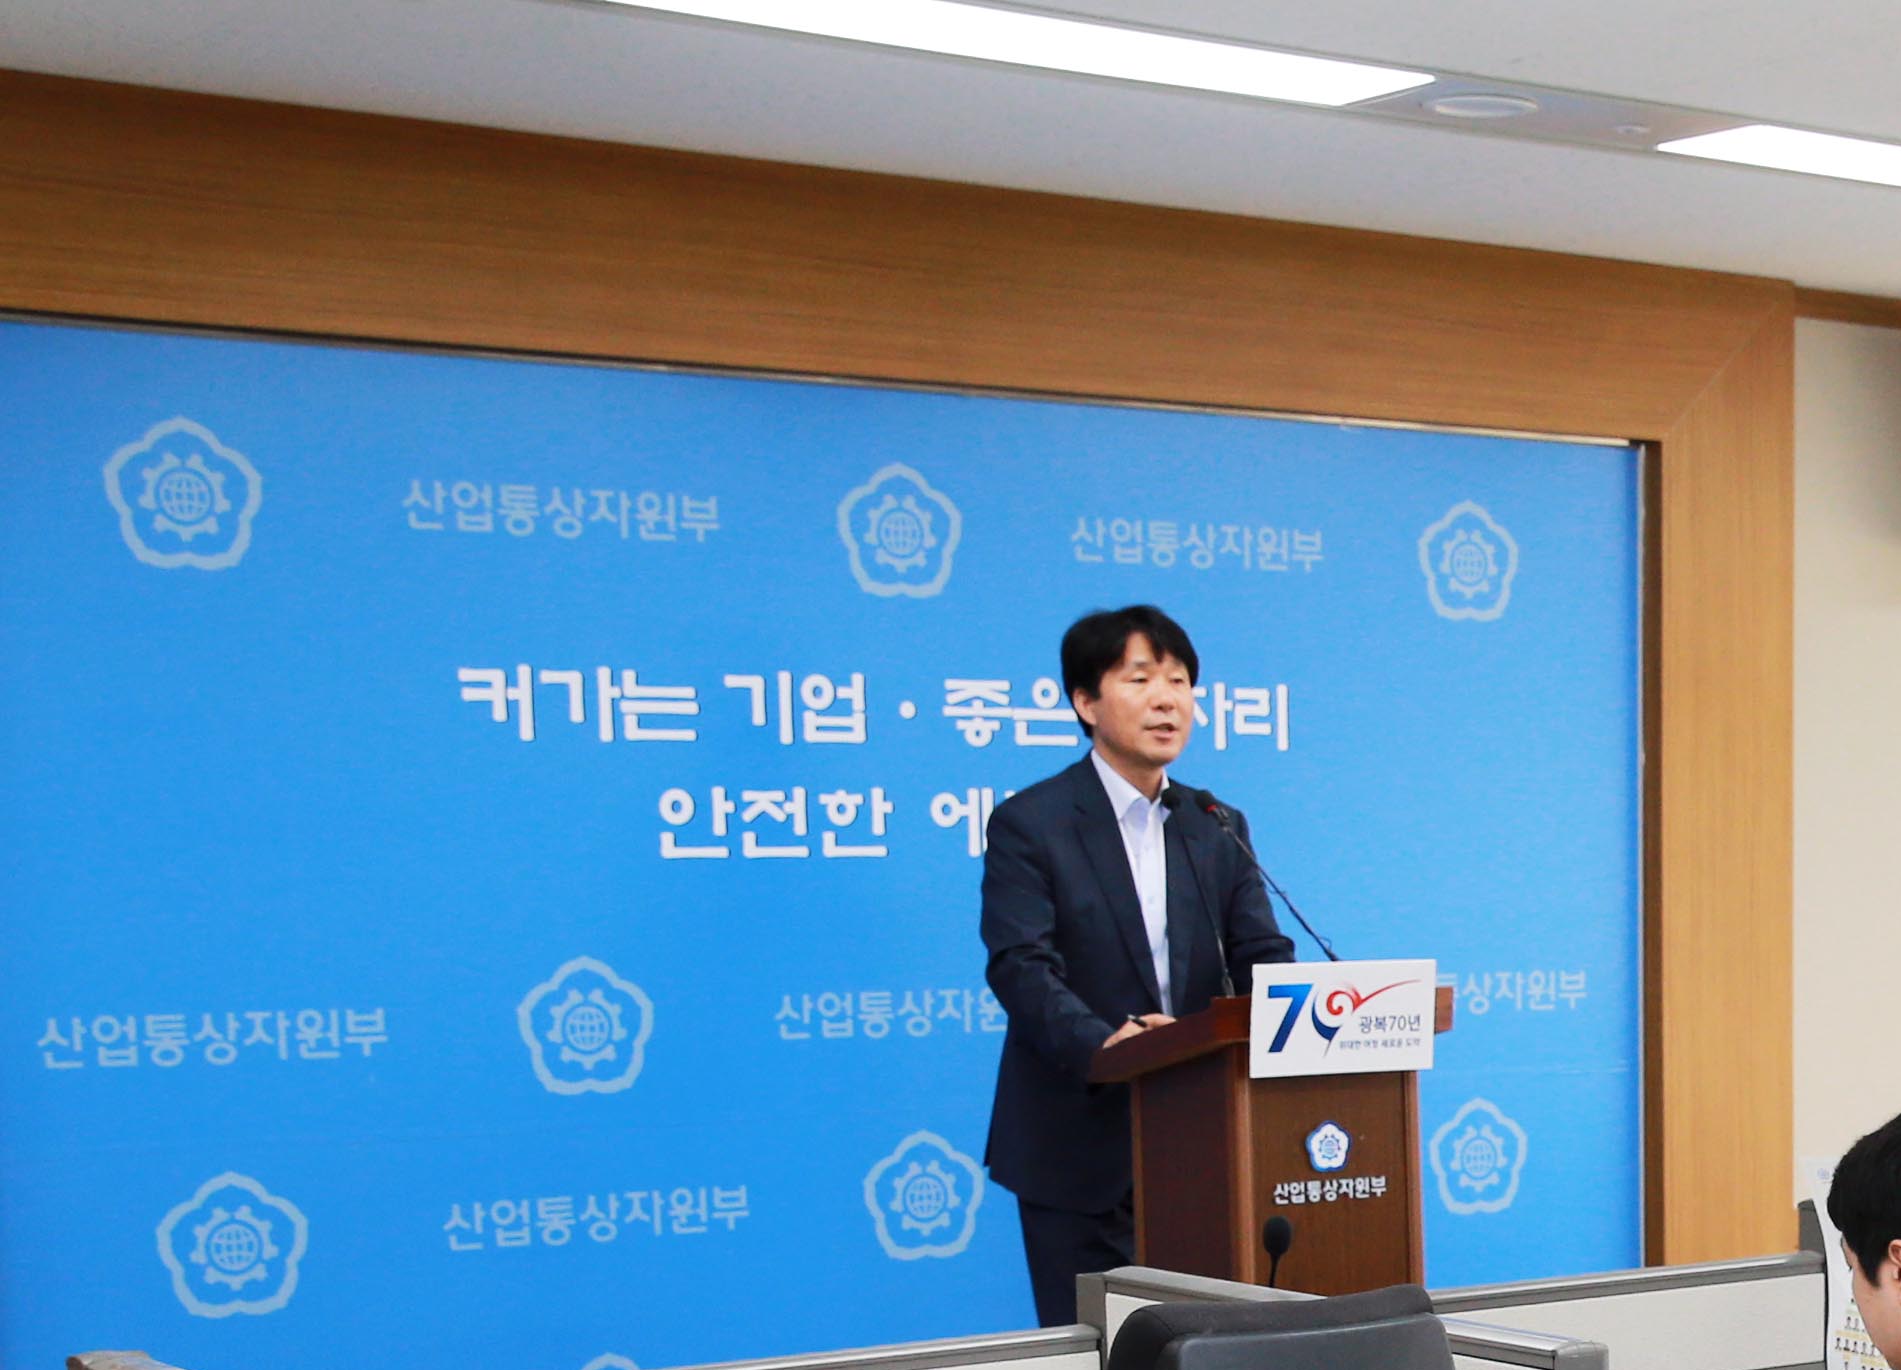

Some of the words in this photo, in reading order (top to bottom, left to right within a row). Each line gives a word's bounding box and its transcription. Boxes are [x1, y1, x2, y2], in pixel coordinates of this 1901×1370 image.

[402, 478, 721, 543] 산업통상자원부
[1071, 516, 1325, 573] 산업통상자원부
[457, 664, 700, 742] 커가는
[724, 671, 867, 744] 기업
[942, 677, 1080, 748] 좋은
[659, 784, 893, 859] 안전한
[774, 987, 1008, 1041] 산업통상자원
[1437, 970, 1588, 1016] 상자원부
[37, 1008, 389, 1070] 산업통상자원부
[443, 1184, 751, 1251] 산업통상자원부
[1273, 1175, 1387, 1205] 산업통상자원부
